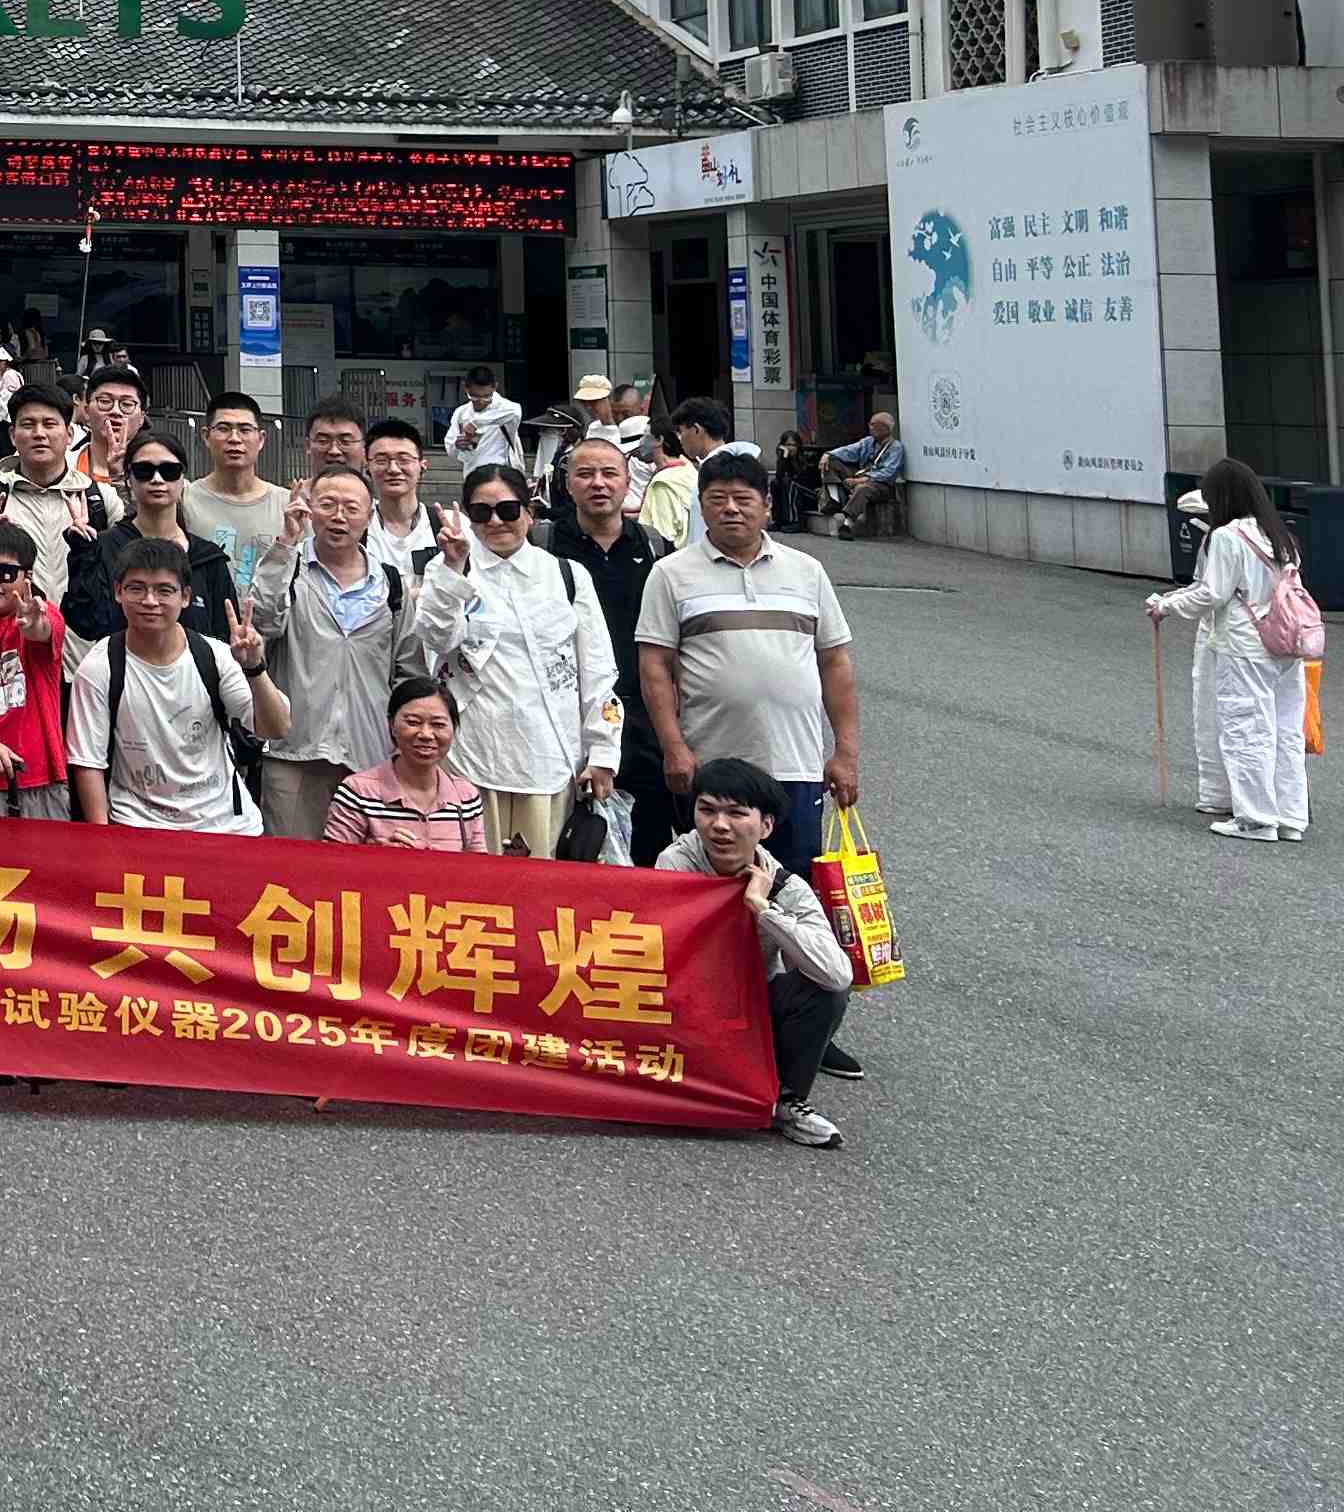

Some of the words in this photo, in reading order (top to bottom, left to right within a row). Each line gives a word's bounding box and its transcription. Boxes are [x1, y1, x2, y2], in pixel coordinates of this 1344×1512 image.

[988, 215, 1015, 240] 富强
[1024, 213, 1051, 238] 民主
[1061, 209, 1088, 233] 文明
[1098, 205, 1129, 232] 和谐
[992, 258, 1016, 282] 自由
[1025, 255, 1053, 281] 平等
[1064, 253, 1091, 278] 公正
[1101, 250, 1130, 277] 法治
[993, 300, 1019, 325] 爱国
[1028, 299, 1056, 324] 敬业
[1065, 298, 1093, 323] 诚信
[1104, 296, 1133, 322] 友善
[761, 273, 781, 384] 中国体育彩票
[89, 872, 674, 1026] 共创辉煌
